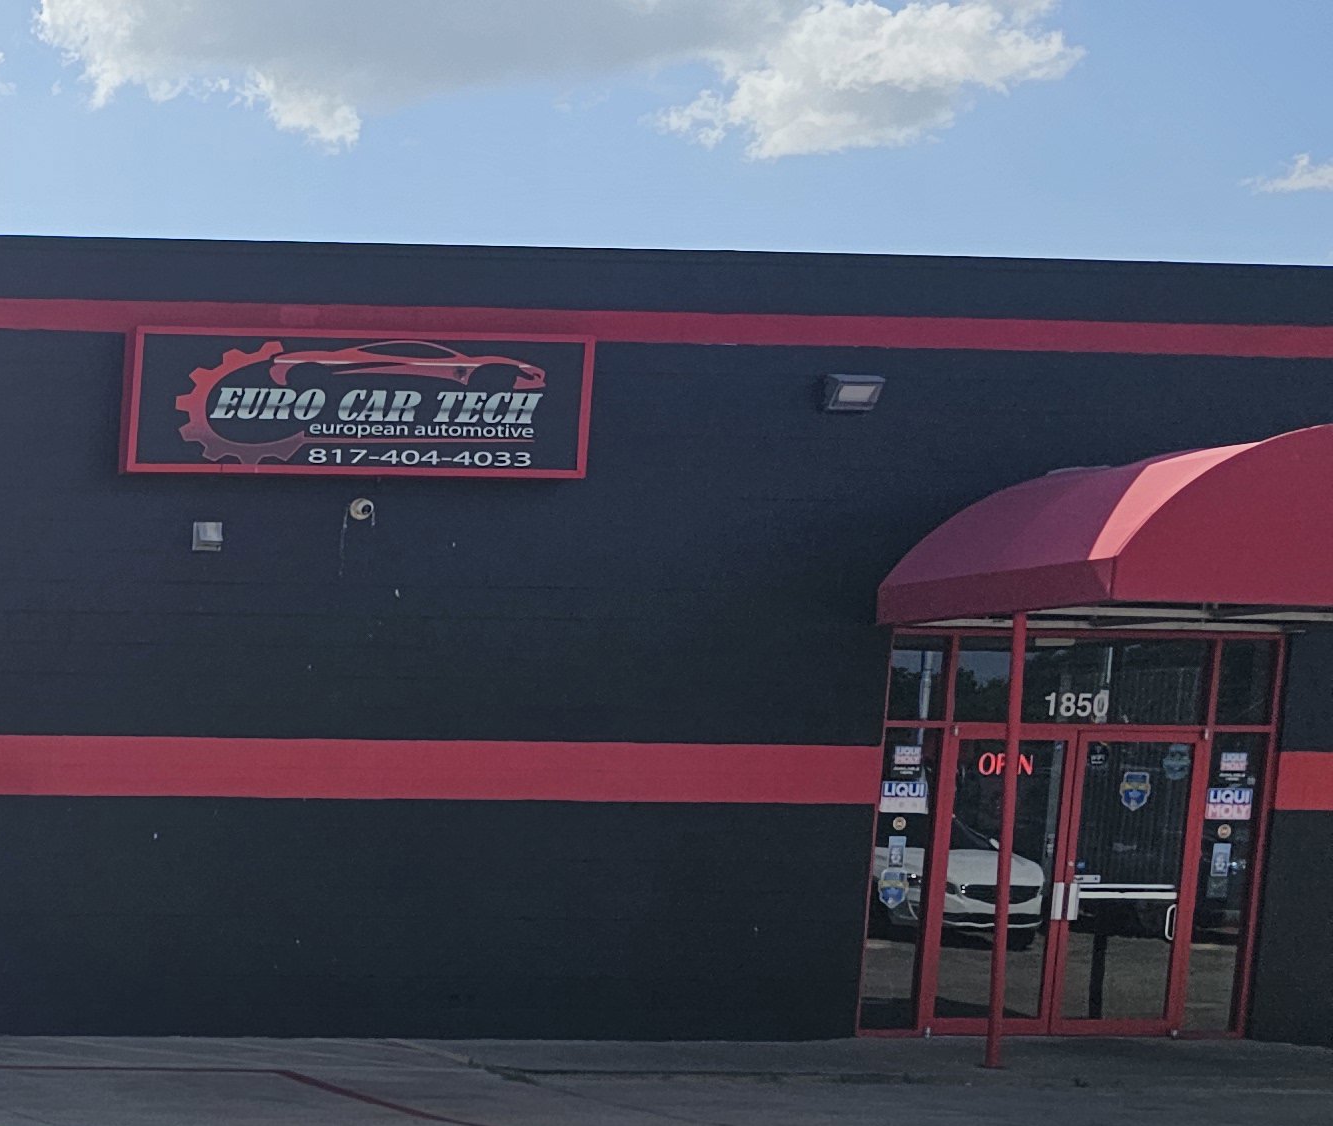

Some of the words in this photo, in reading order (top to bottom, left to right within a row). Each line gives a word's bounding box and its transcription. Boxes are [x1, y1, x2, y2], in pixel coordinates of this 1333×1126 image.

[209, 387, 326, 421] EURO
[337, 388, 421, 422] CAR
[432, 391, 543, 424] TECH
[309, 422, 408, 438] european
[414, 423, 534, 438] automotive
[308, 448, 532, 467] 817-404-4033
[1045, 692, 1109, 717] 1850
[978, 752, 1033, 775] OPN
[884, 783, 925, 797] LIQUI
[1209, 789, 1251, 803] LIQUI
[1207, 804, 1248, 818] MOLY
